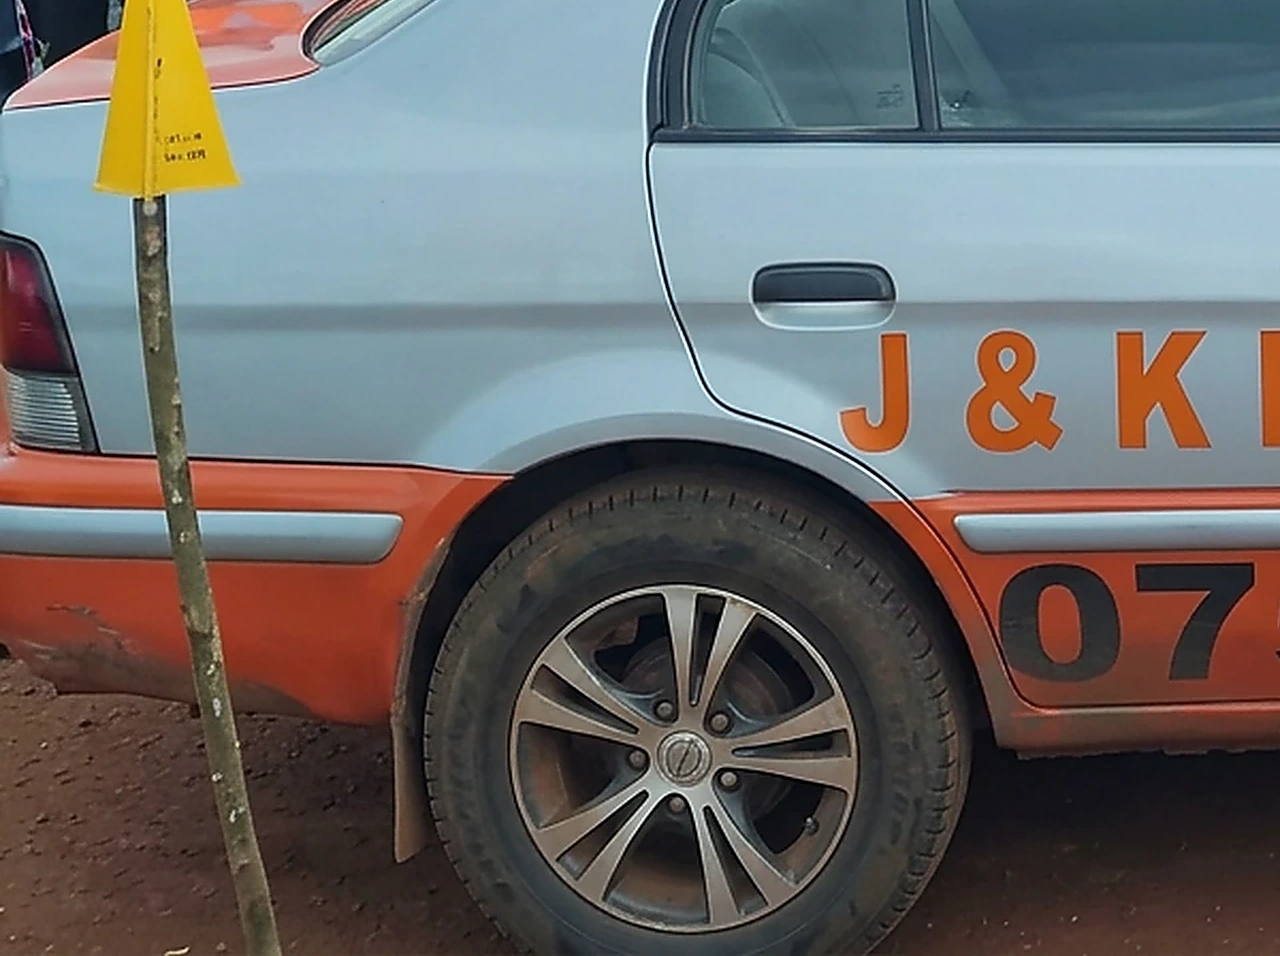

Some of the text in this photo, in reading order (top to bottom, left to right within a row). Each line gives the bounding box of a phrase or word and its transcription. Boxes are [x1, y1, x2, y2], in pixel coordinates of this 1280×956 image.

[840, 333, 910, 453] J
[966, 330, 1063, 453] &
[1116, 331, 1211, 449] K
